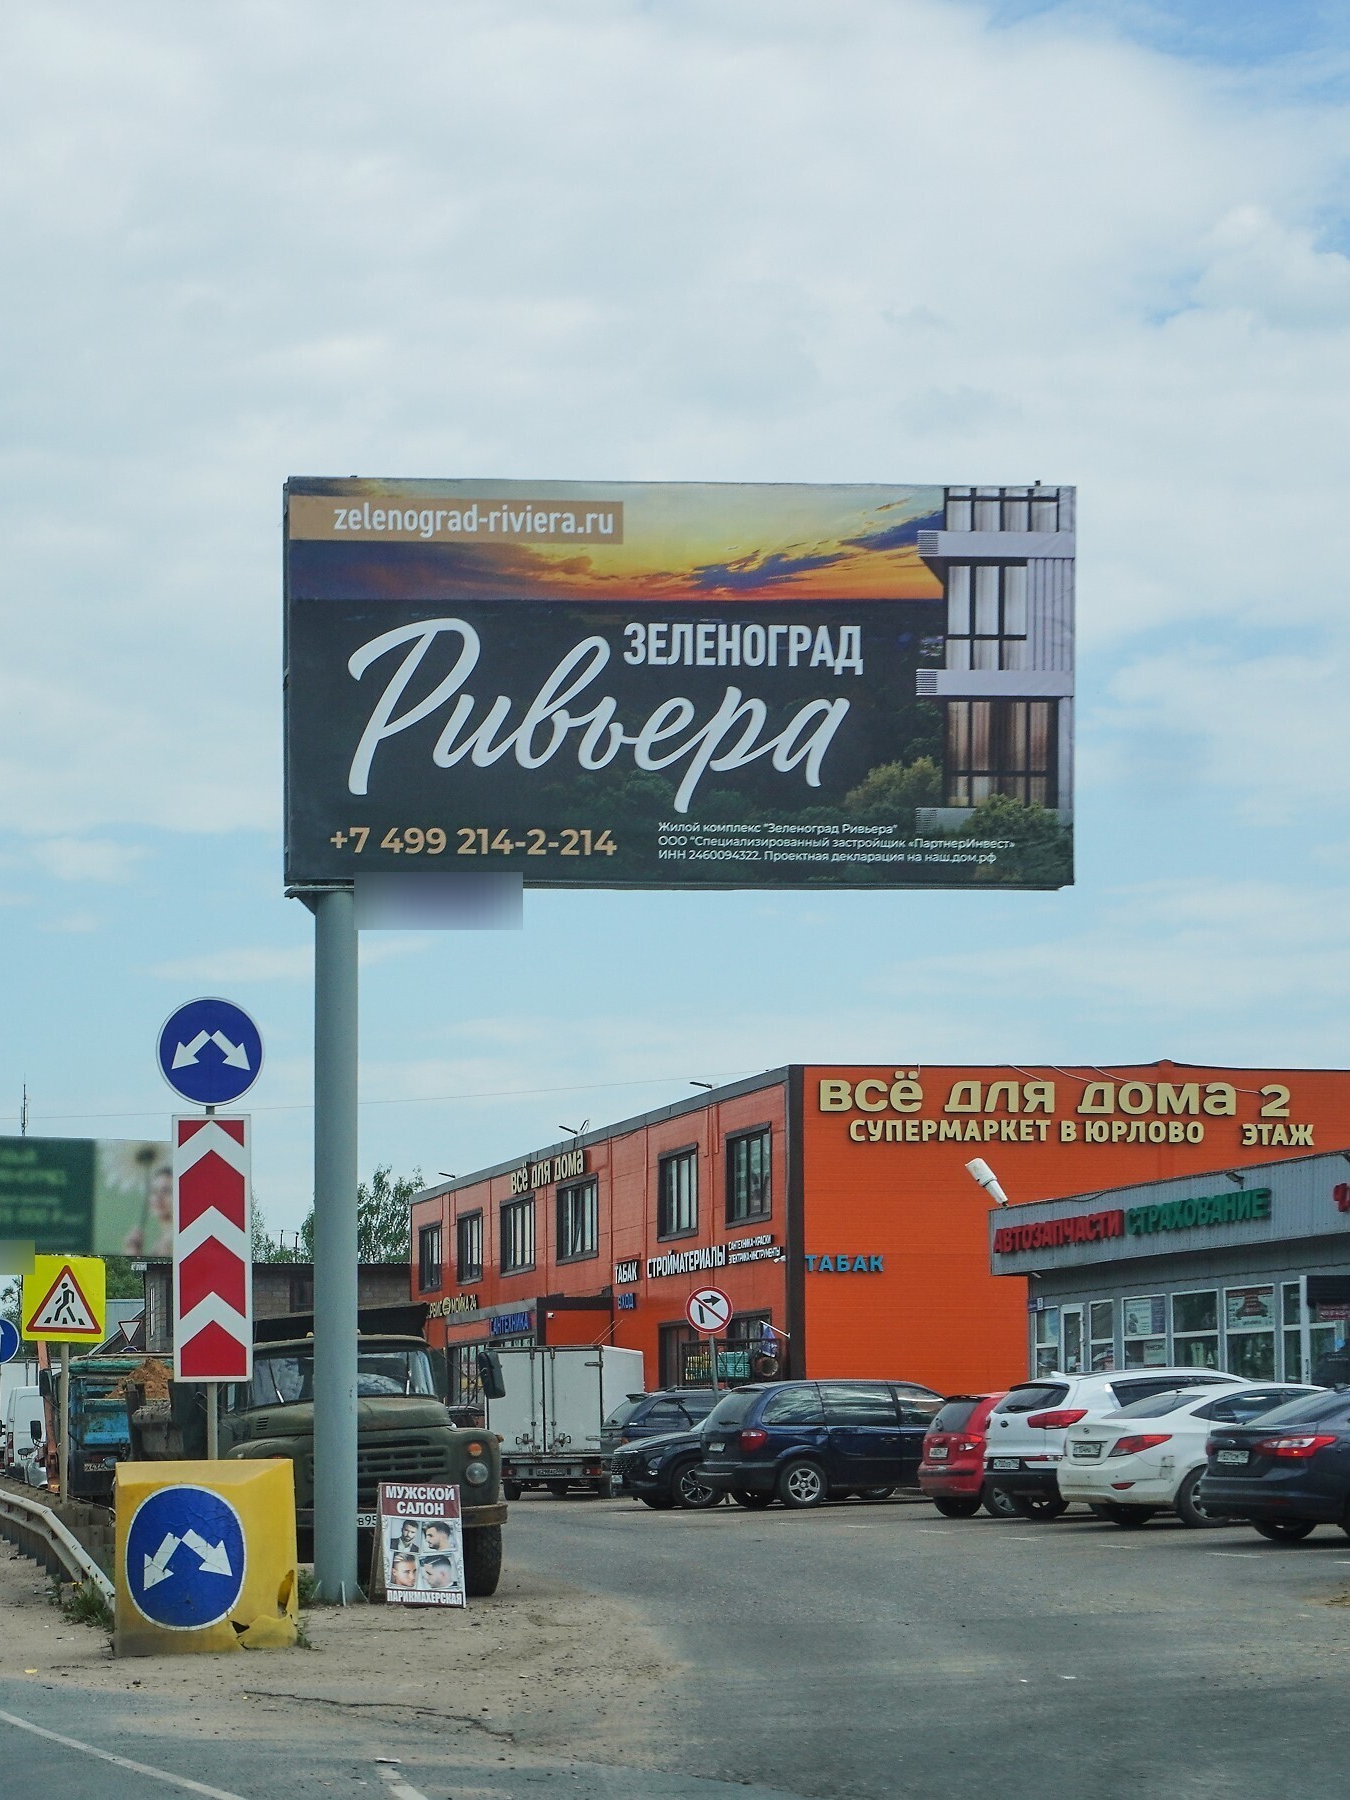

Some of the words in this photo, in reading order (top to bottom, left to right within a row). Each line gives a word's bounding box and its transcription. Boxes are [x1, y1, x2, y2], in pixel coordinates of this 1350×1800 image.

[334, 502, 613, 538] zelenograd-riviera.ru
[623, 623, 863, 675] ЗЕЛЕНОГРАД
[348, 618, 850, 813] Ривьера
[658, 822, 700, 833] Жилой
[703, 824, 761, 833] комплекс
[330, 827, 370, 853] +7
[380, 827, 447, 854] 499
[456, 828, 617, 856] 214-2-214
[658, 836, 687, 846] ООО
[832, 838, 906, 850] застройщик
[658, 850, 686, 860] ИНН
[764, 851, 828, 862] Проектная
[831, 852, 903, 863] декларация
[907, 854, 922, 862] на
[925, 853, 996, 864] наш.дом.рф
[1260, 1084, 1291, 1117] 2
[850, 1119, 1051, 1142] СУПЕРМАРКЕТ
[1060, 1120, 1077, 1142] В
[1085, 1120, 1205, 1144] ЮРЛОВО
[1242, 1123, 1314, 1145] ЭТАЖ
[1125, 1187, 1272, 1236] СТРАХОВАНИЕ
[993, 1209, 1125, 1254] АВТОЗАПЧАСТИ
[614, 1261, 638, 1284] ТАБАК
[646, 1245, 726, 1278] СТРОЙМАТЕРИАЛЫ
[805, 1255, 884, 1272] ТАБАК
[489, 1311, 529, 1335] САНТЕХНИКА
[385, 1485, 455, 1500] МУЖСКОЙ
[396, 1501, 444, 1515] САЛОН
[387, 1589, 463, 1605] ПАРИКМАХЕРСКАЯ
